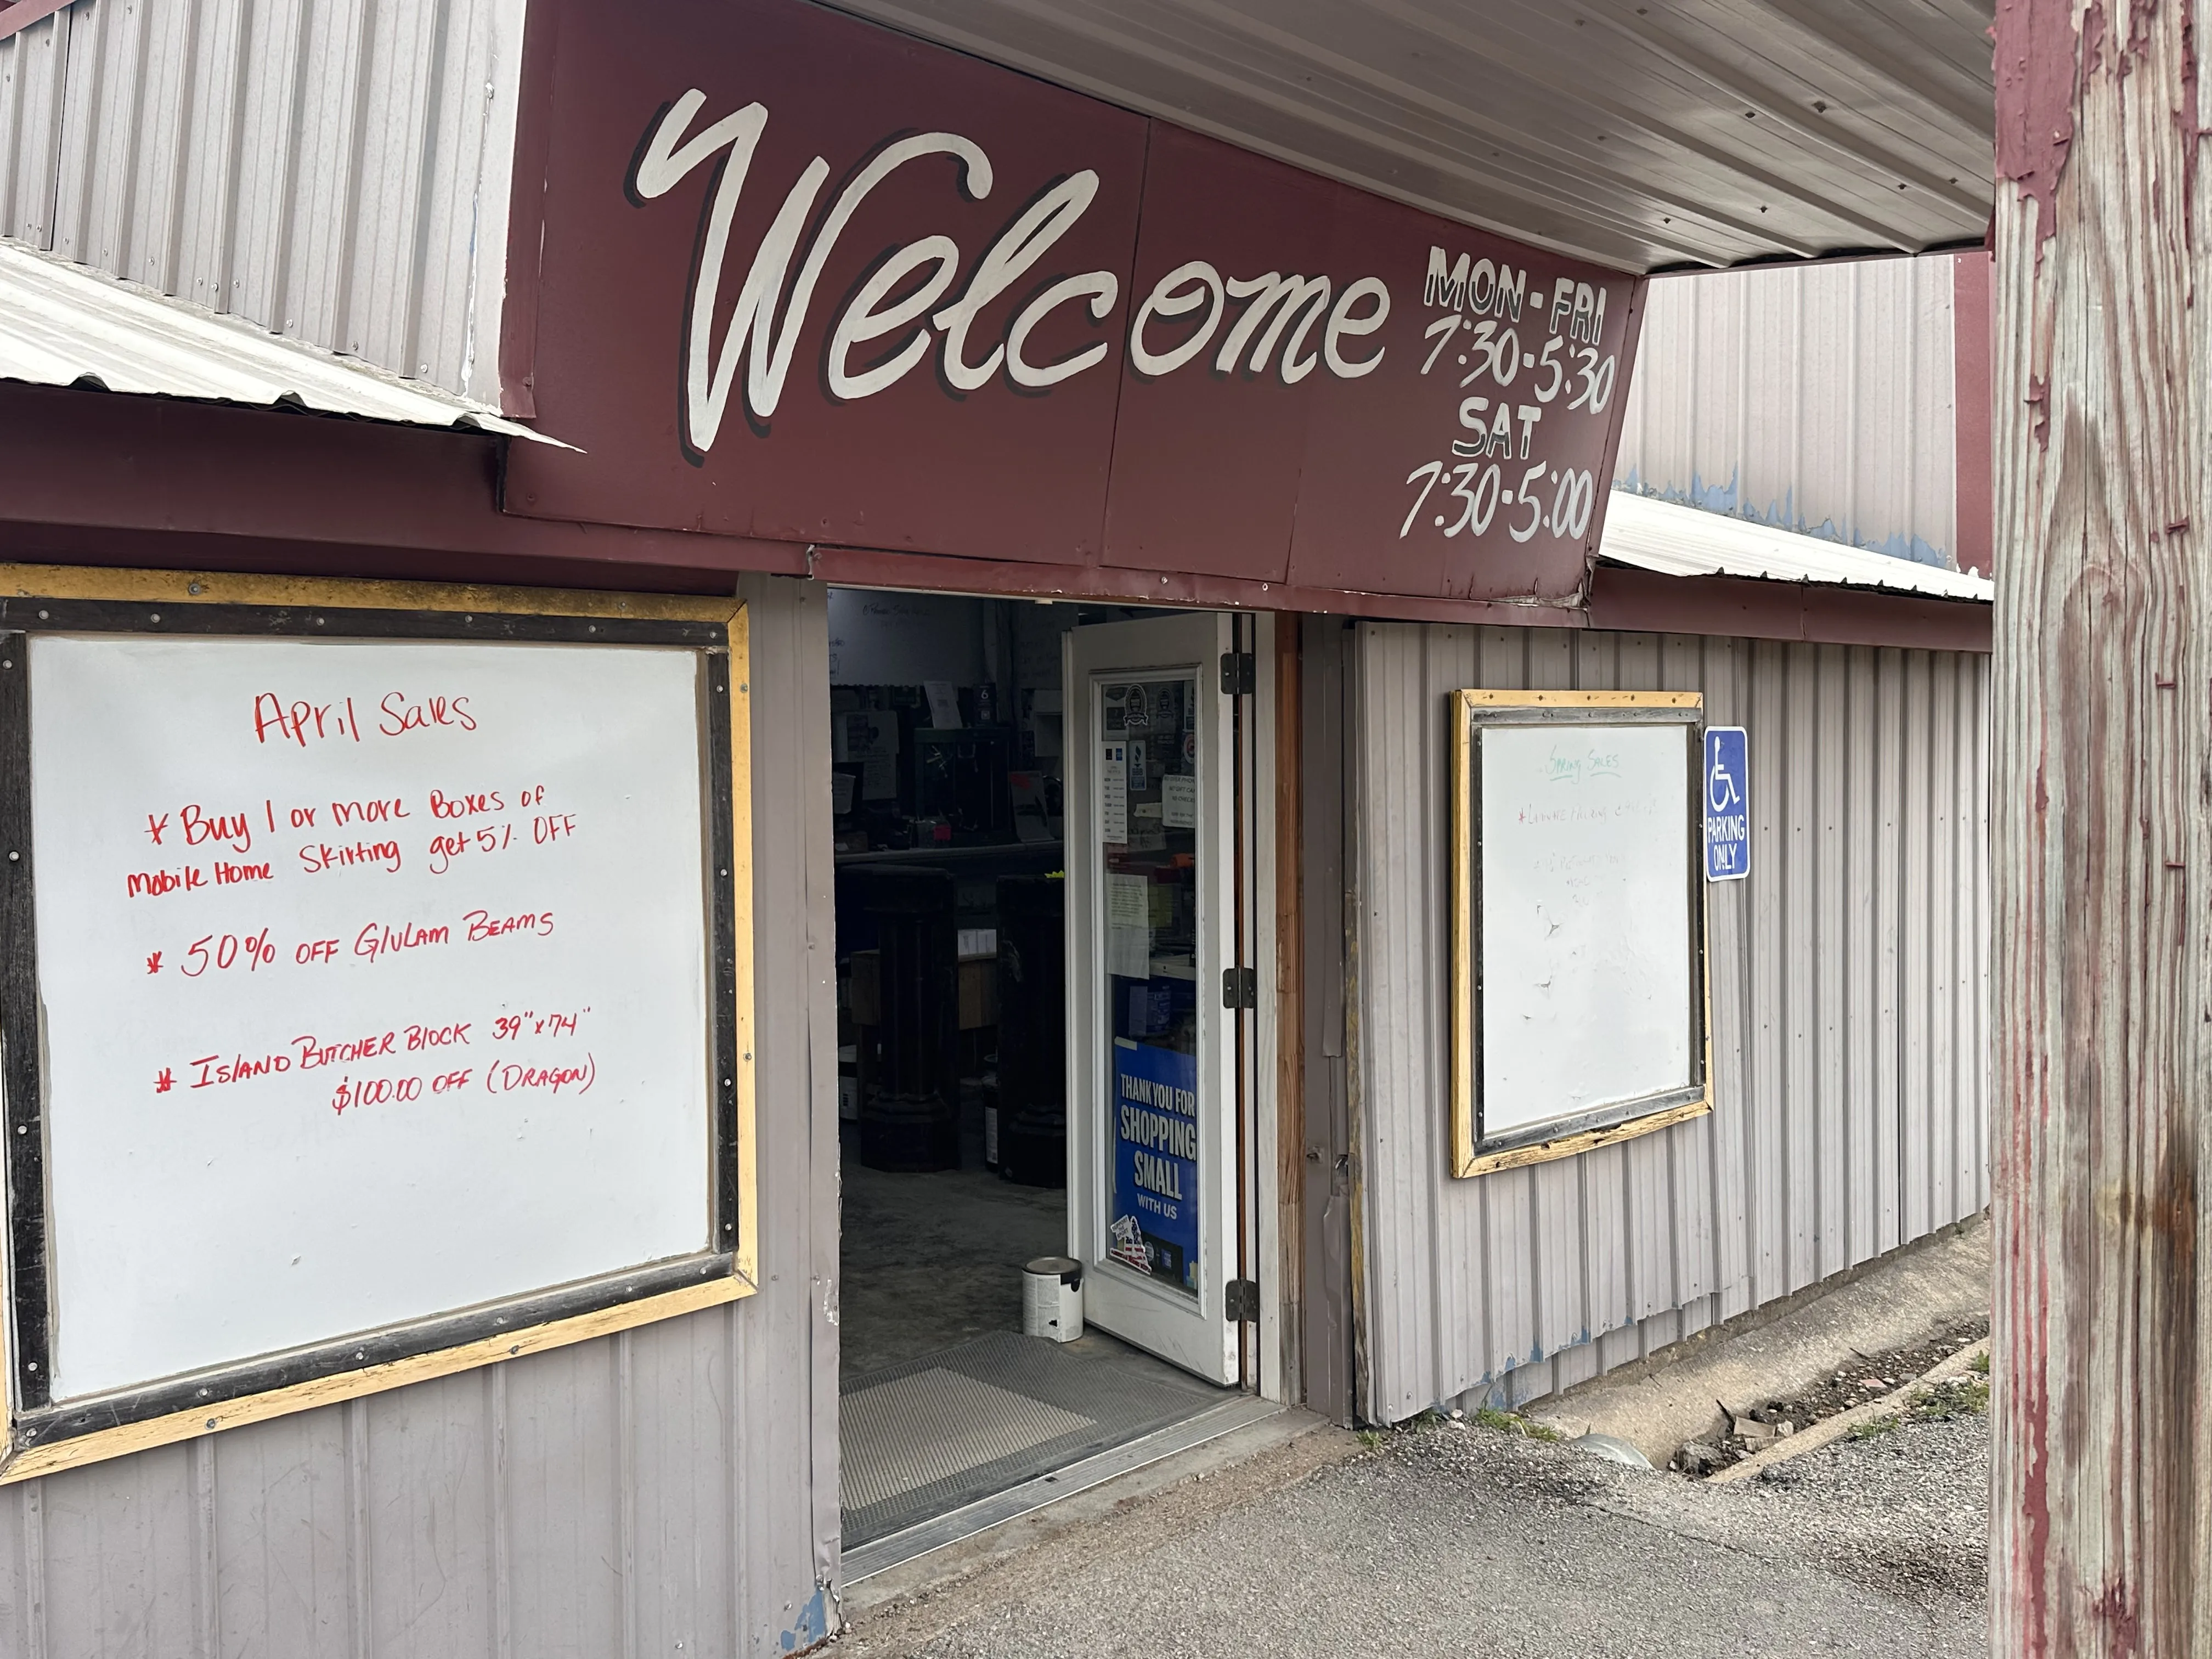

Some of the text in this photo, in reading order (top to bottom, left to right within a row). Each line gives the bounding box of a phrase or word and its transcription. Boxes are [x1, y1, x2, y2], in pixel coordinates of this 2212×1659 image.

[635, 88, 1391, 452] Welcome
[1452, 396, 1542, 460] SAT
[254, 692, 477, 747] April Sales
[179, 804, 251, 854] Buy
[290, 808, 316, 829] or
[331, 797, 410, 829] more
[430, 788, 505, 819] Boxes
[520, 785, 545, 807] of
[1708, 815, 1745, 843] PARKING
[127, 865, 207, 898] Mobile
[214, 862, 273, 885] Home
[298, 840, 402, 874] Skirting
[429, 831, 470, 874] get
[533, 814, 577, 845] OFF
[1713, 843, 1737, 871] ONLY
[181, 928, 275, 977] 50%
[295, 939, 339, 964] OFF
[464, 909, 553, 942] BEAMS
[291, 1035, 396, 1069] BUTCHER
[331, 1052, 596, 1116] $100.00 OFF (DRAGON)
[1121, 1073, 1195, 1117] THANK YOU FOR
[1120, 1104, 1197, 1161] SHOPPING
[1135, 1150, 1182, 1200] SMALL
[1137, 1193, 1177, 1220] WITH US
